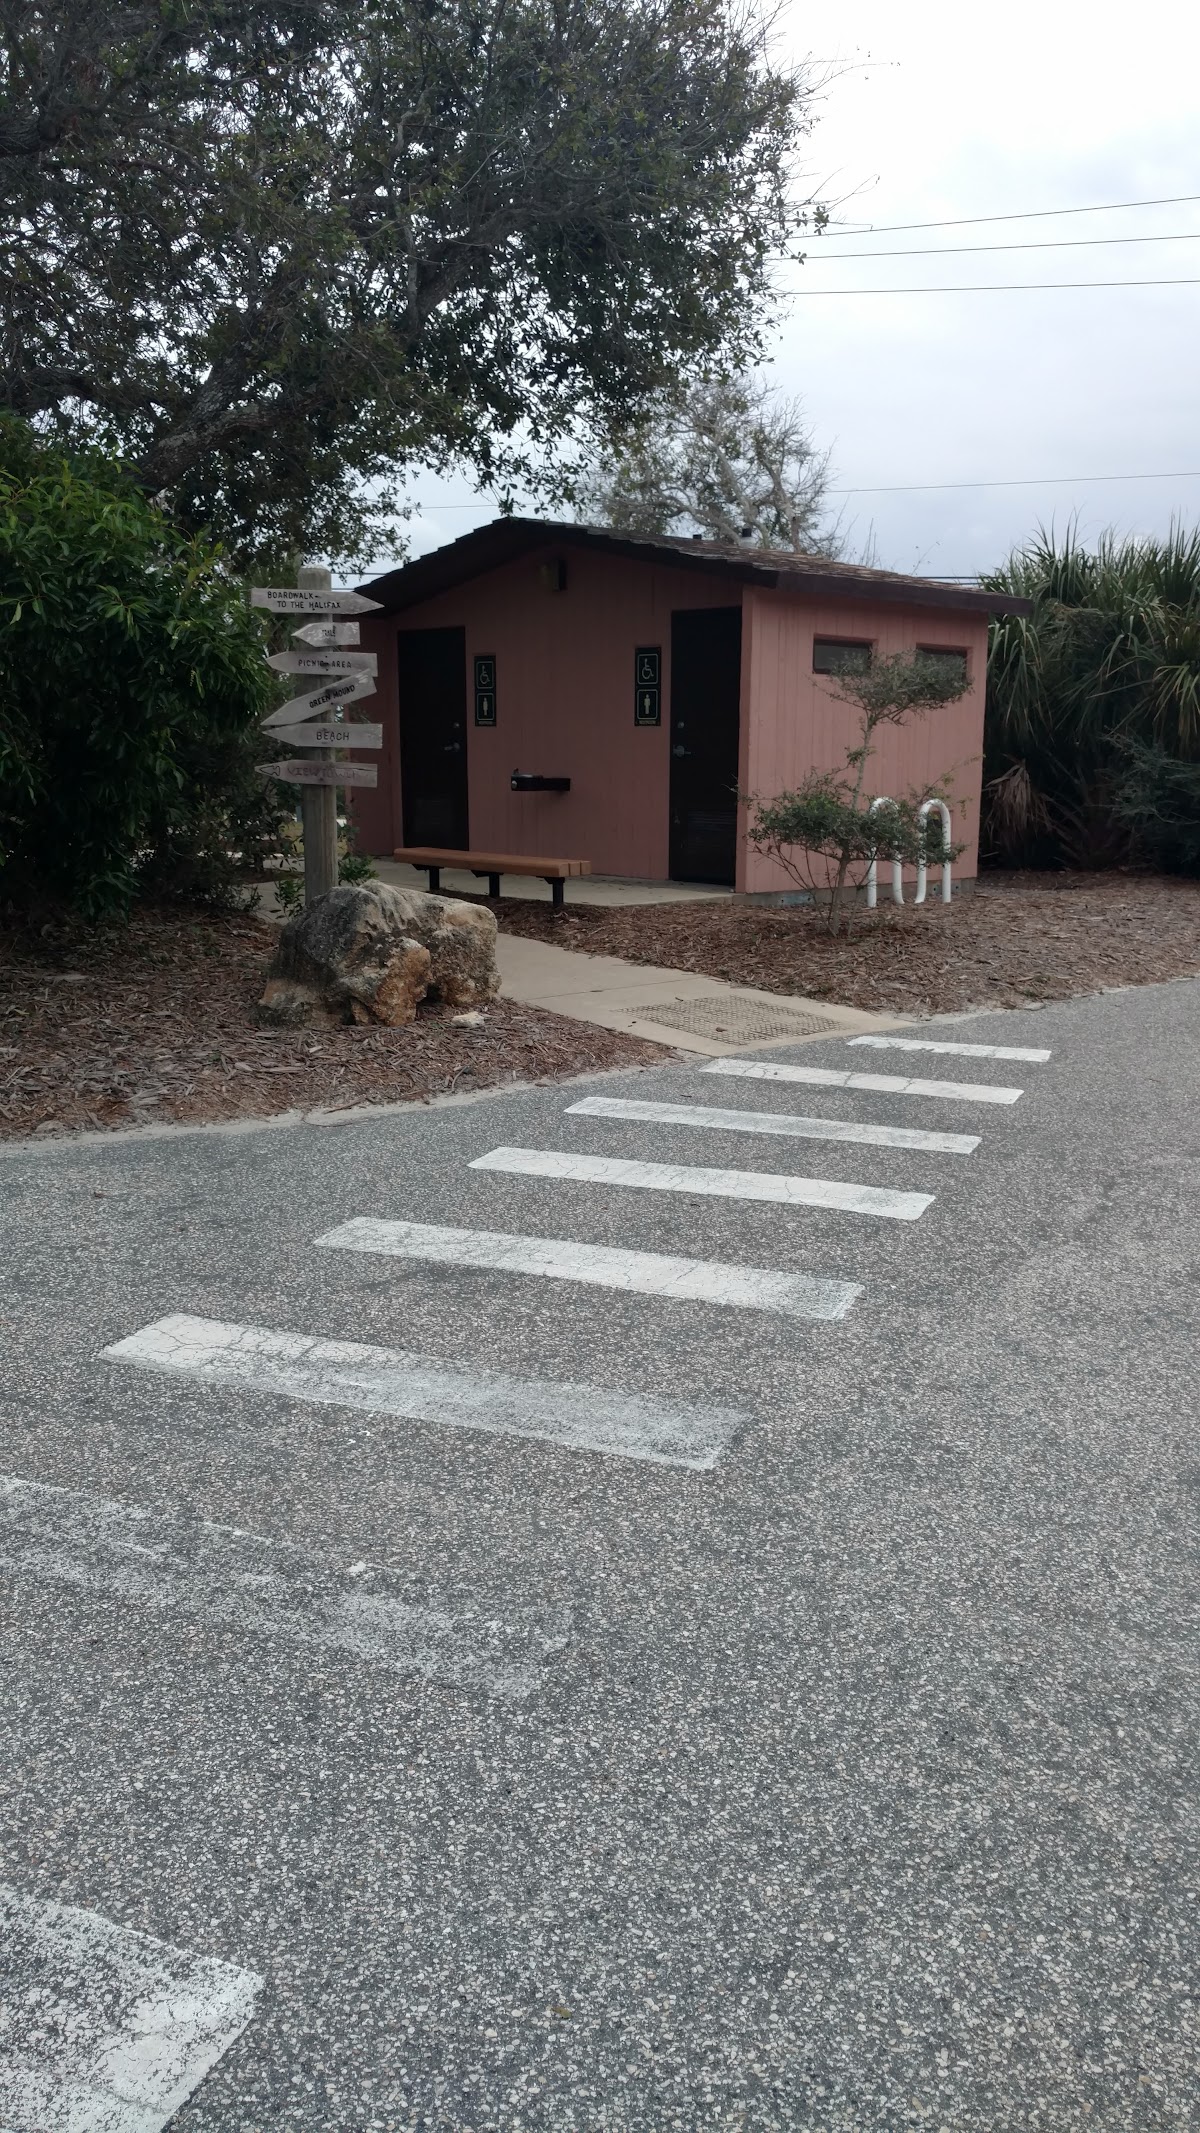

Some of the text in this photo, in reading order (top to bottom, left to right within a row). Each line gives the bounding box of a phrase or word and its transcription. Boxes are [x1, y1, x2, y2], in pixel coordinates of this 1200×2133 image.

[277, 600, 341, 609] TO THE HALIFAX
[331, 660, 352, 668] AREA
[309, 684, 356, 708] GREEN MOUND
[316, 731, 350, 741] BEACH
